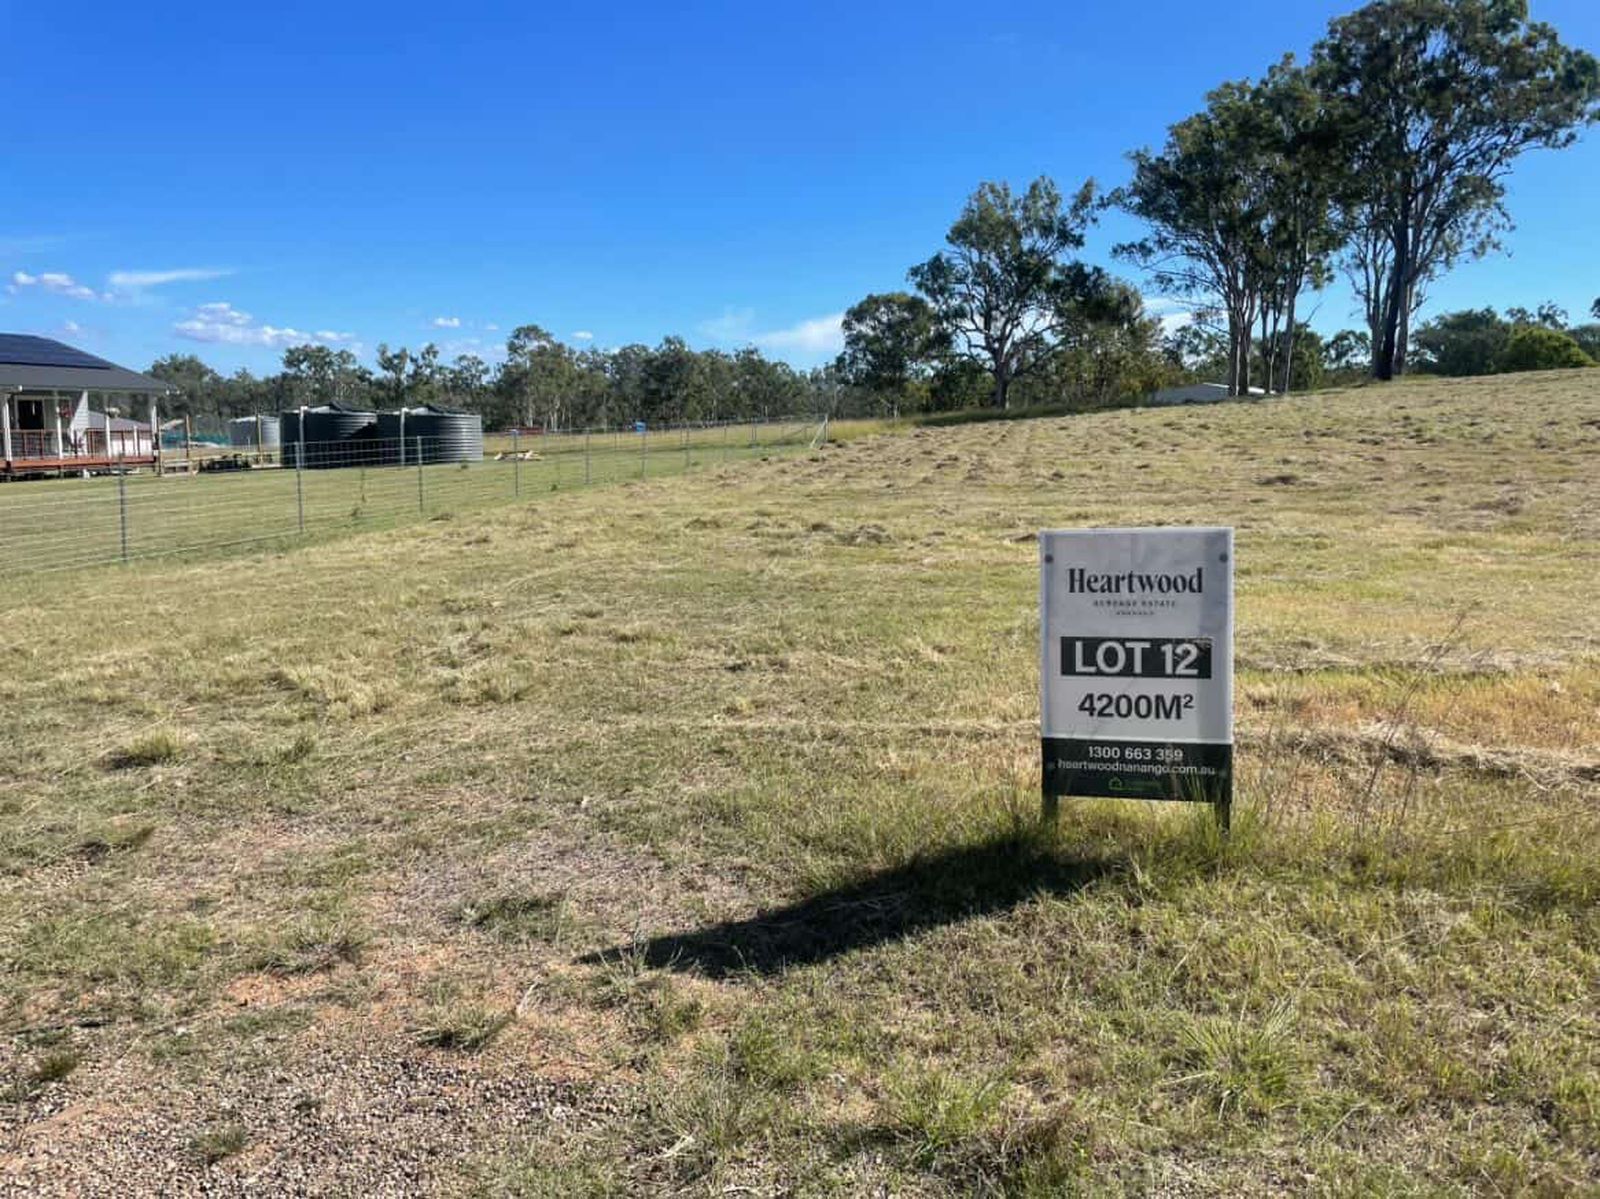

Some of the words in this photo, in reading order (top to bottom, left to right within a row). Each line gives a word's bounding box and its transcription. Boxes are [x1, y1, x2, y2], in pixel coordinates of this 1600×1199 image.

[1068, 567, 1204, 594] Heartwood
[1075, 640, 1151, 675] LOT
[1161, 643, 1199, 676] 12
[1088, 746, 1121, 759] 1300
[1124, 747, 1151, 761] 663
[1156, 748, 1183, 762] 359
[1057, 758, 1216, 776] heartwoodnanango.com.au
